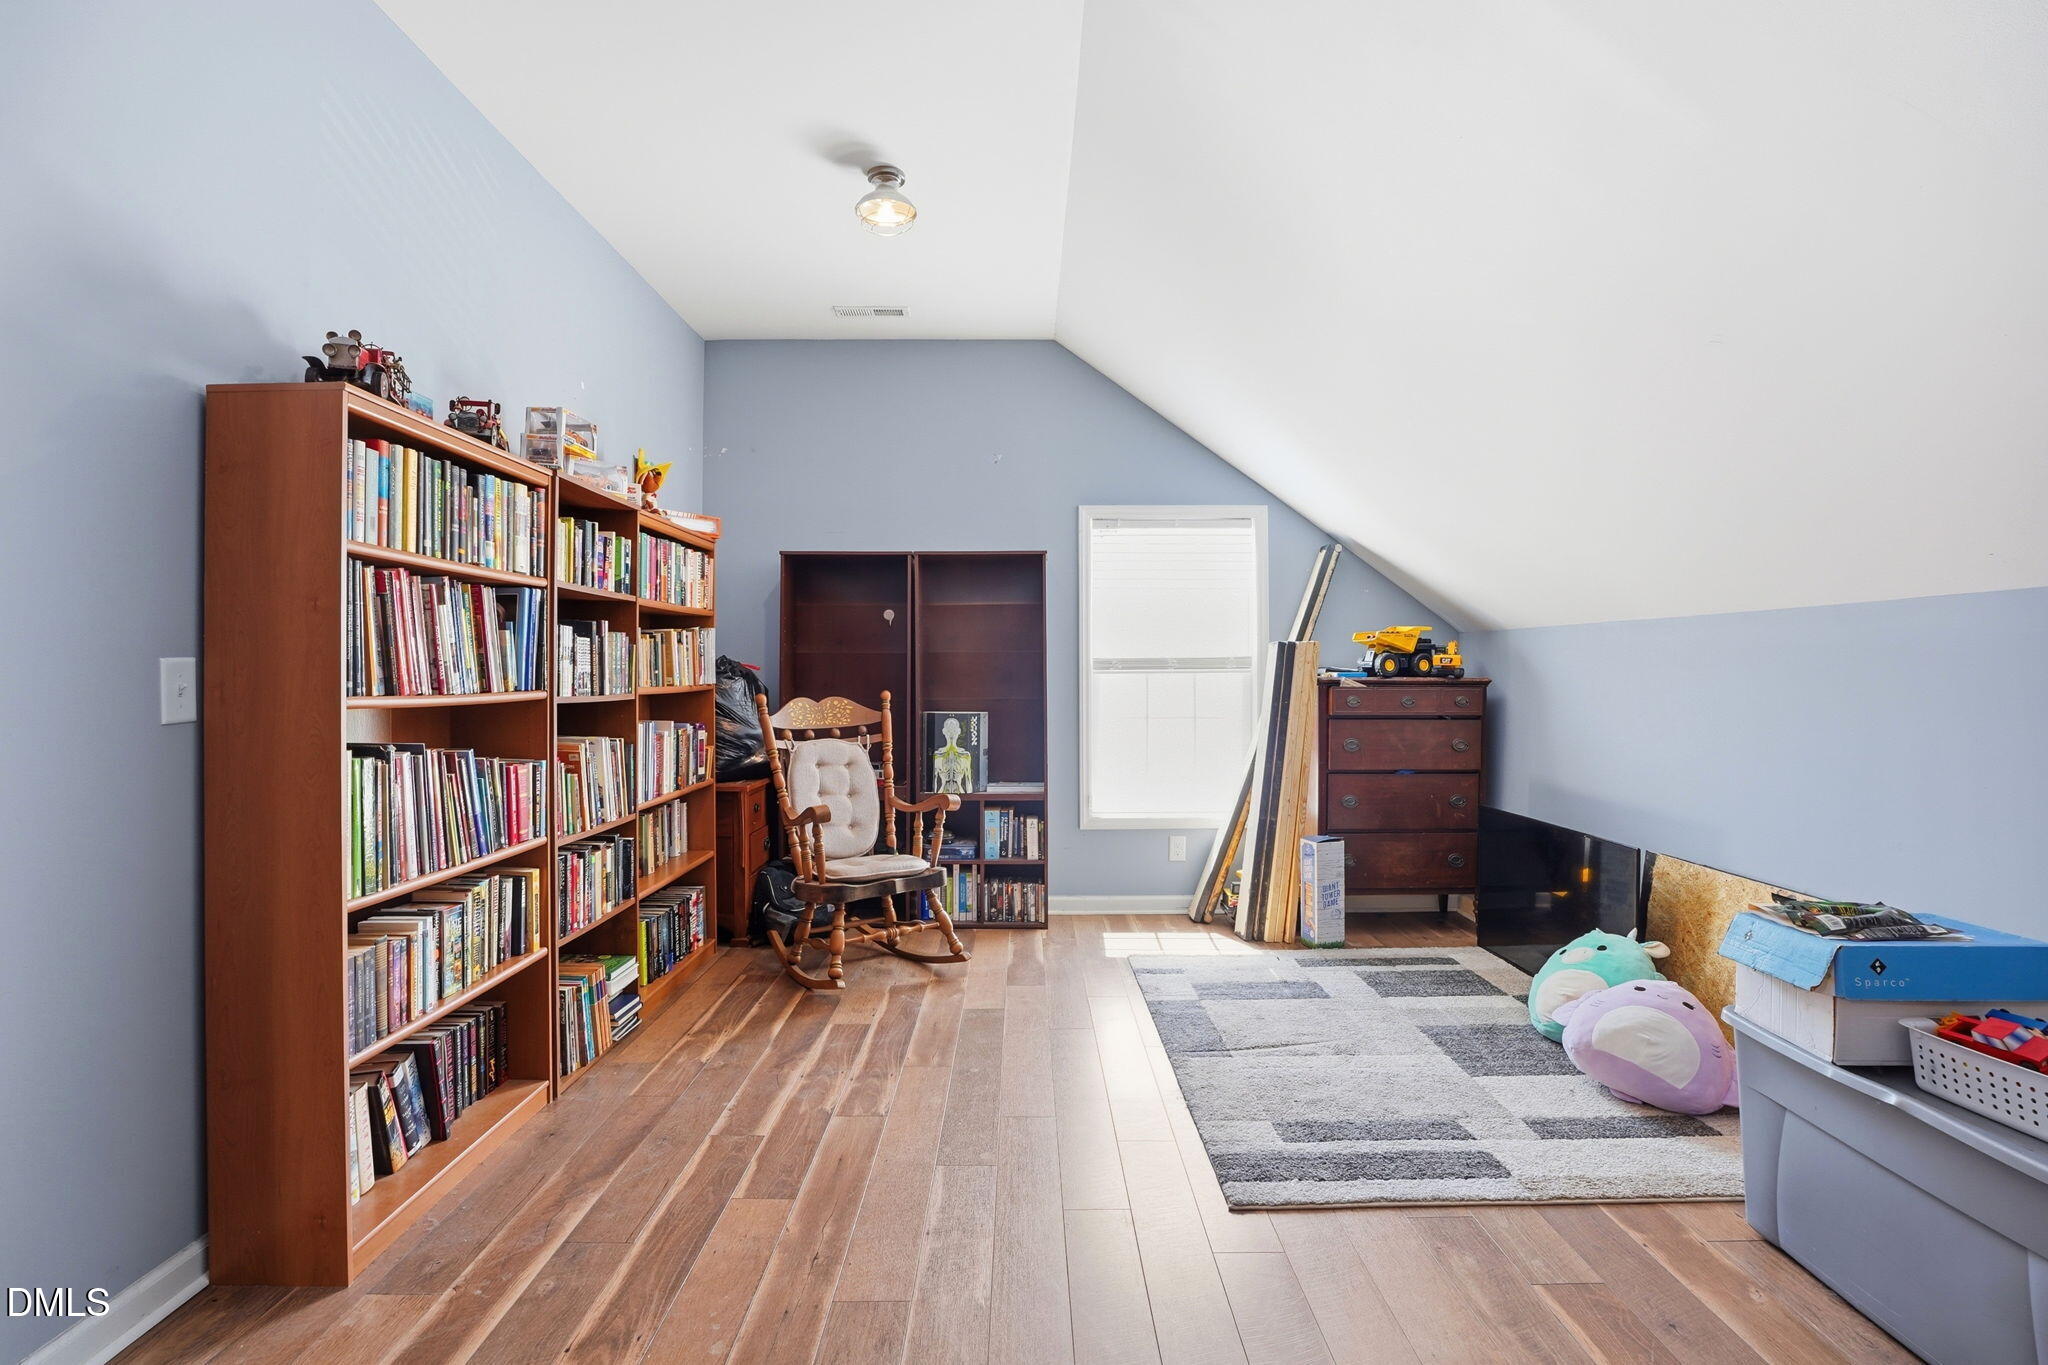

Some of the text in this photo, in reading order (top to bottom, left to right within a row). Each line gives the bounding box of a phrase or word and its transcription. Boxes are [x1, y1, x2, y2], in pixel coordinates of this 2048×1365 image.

[1322, 880, 1340, 893] GIANT
[1321, 889, 1341, 901] TOWER
[1322, 895, 1339, 909] GAME
[1854, 976, 1905, 989] Sparco
